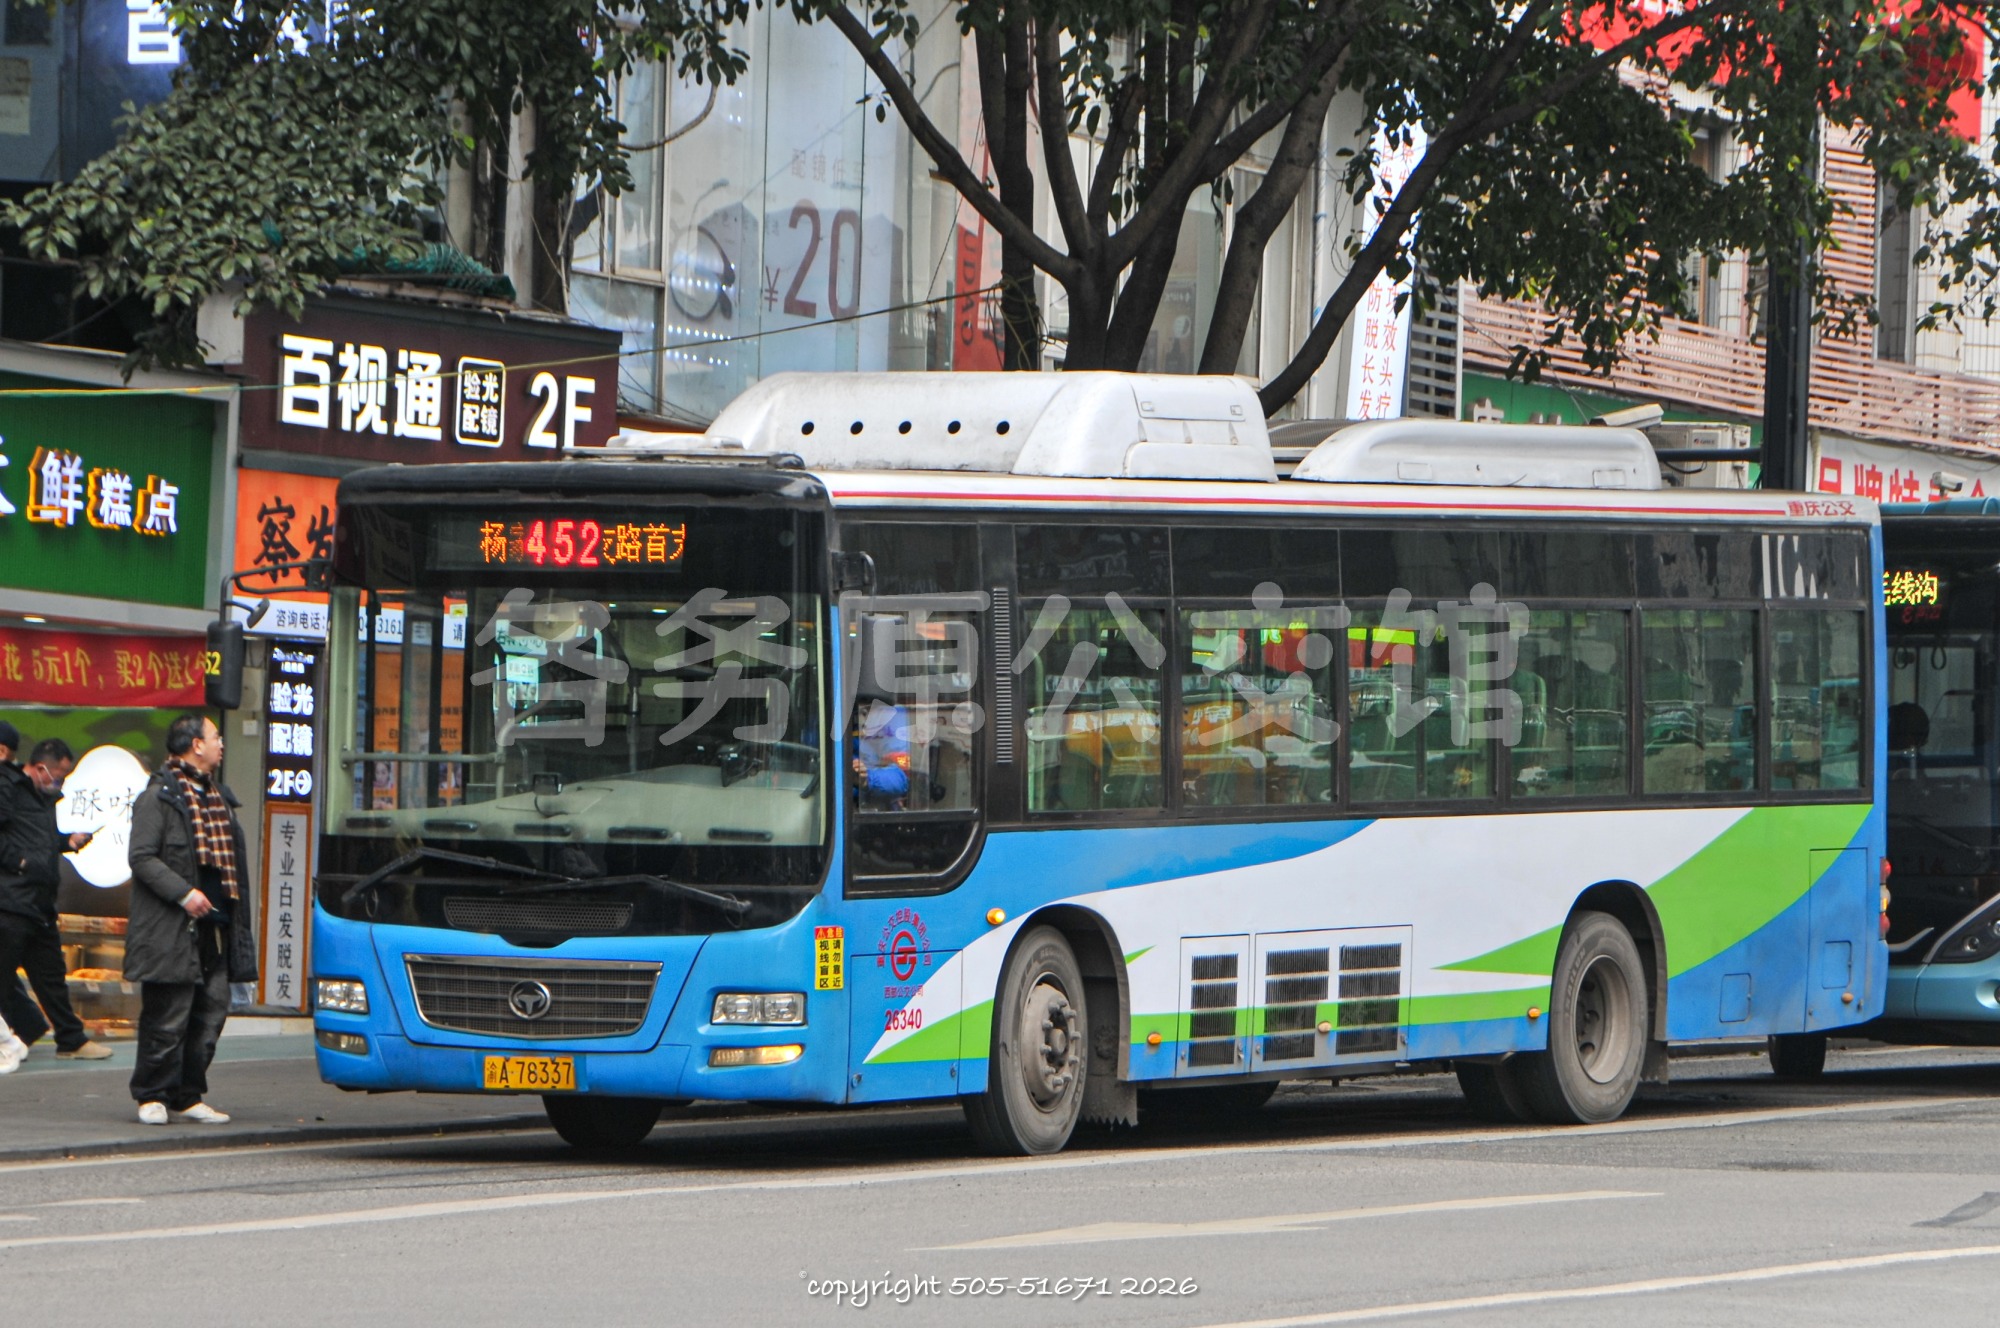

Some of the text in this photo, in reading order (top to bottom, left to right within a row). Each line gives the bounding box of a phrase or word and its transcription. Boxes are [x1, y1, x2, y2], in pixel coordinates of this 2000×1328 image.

[281, 333, 596, 449] 百视通 2F
[463, 370, 500, 404] 验光
[462, 403, 498, 436] 配镜
[38, 449, 180, 533] 鲜糕点
[527, 520, 600, 567] 452
[269, 681, 315, 717] 验光
[269, 722, 314, 757] 配镜
[267, 768, 295, 796] 2F
[275, 820, 297, 1001] 专业白发脱发
[819, 940, 830, 989] 视线盲区
[832, 940, 842, 989] 请勿靠近
[884, 1008, 923, 1031] 26340
